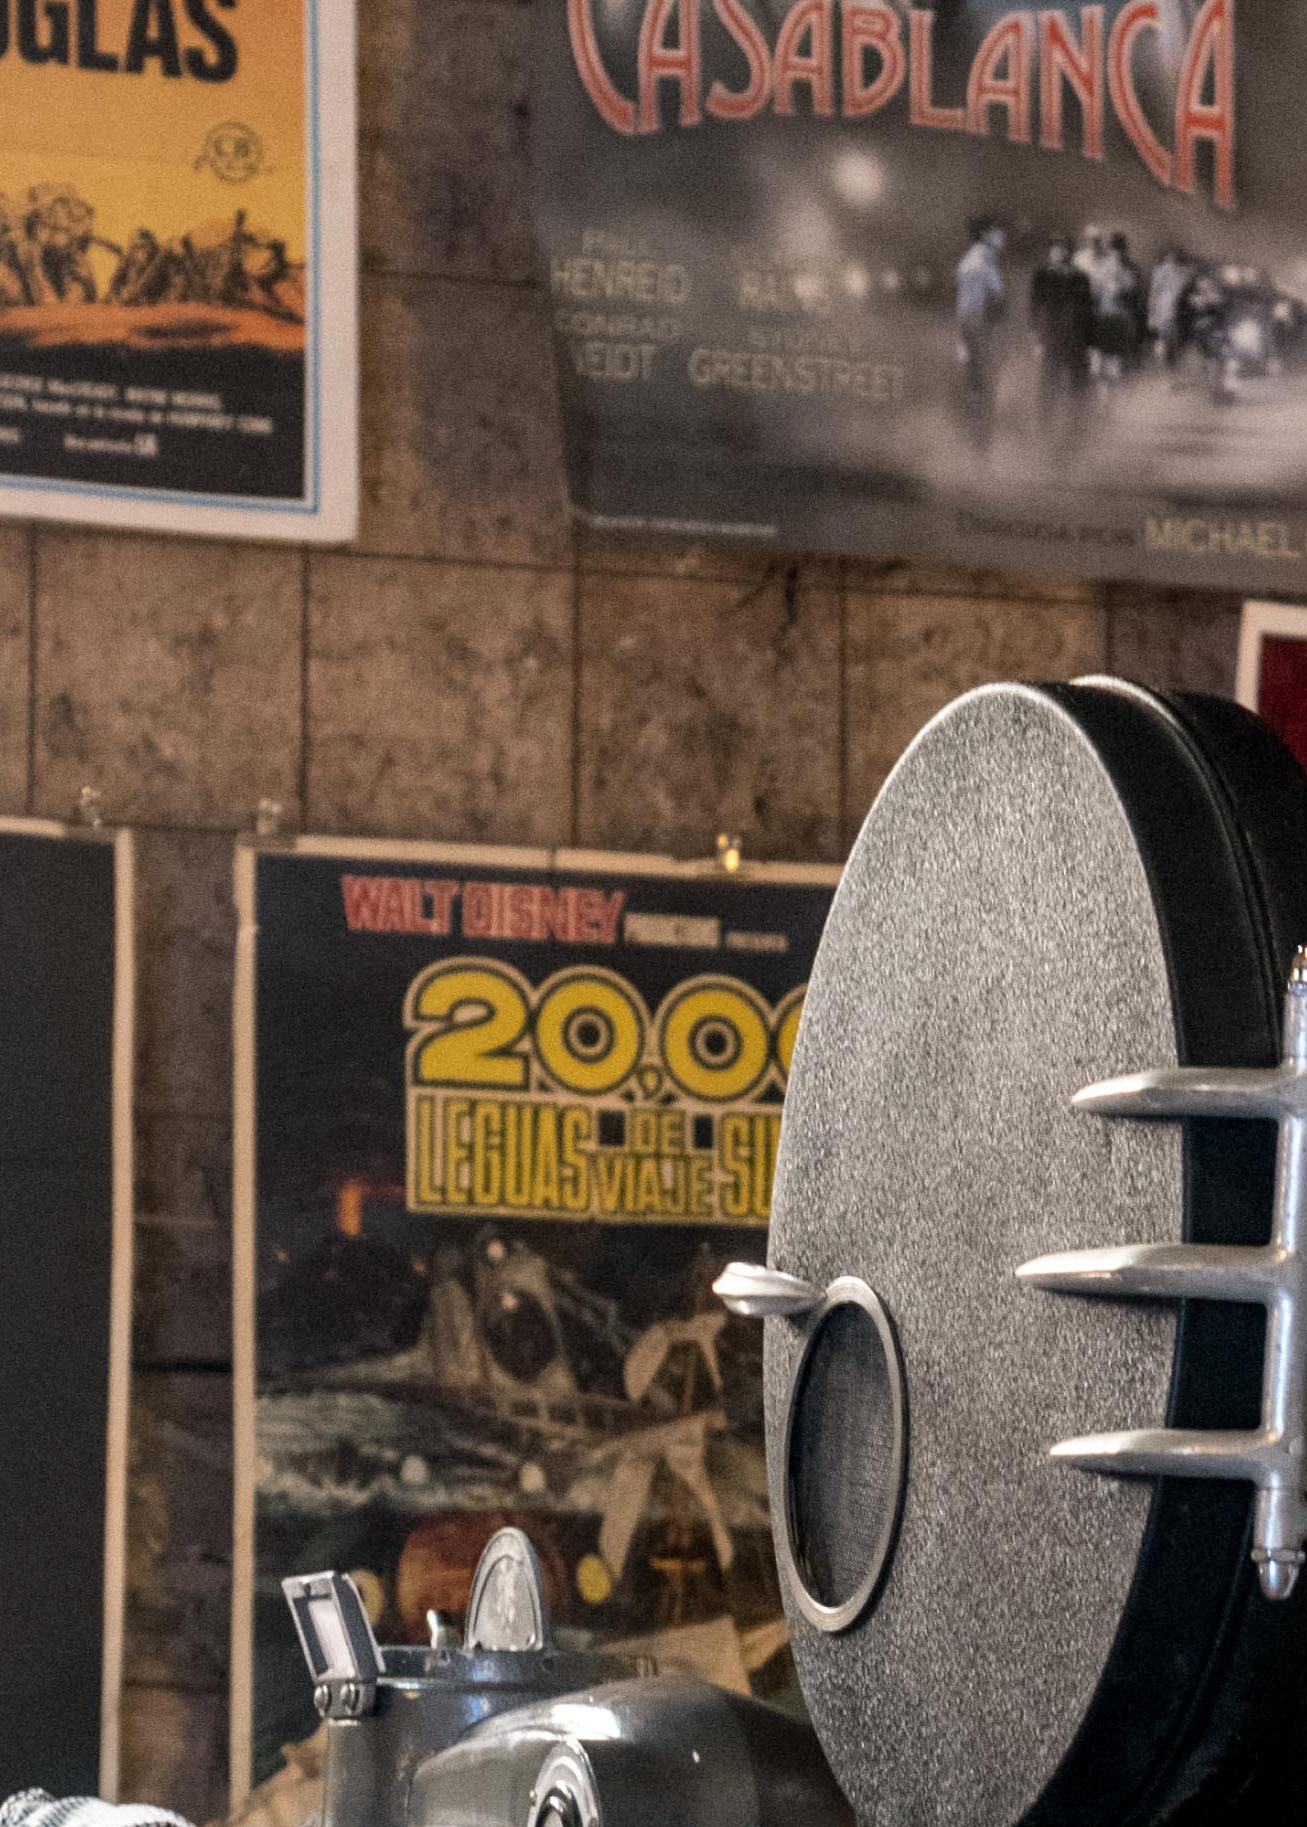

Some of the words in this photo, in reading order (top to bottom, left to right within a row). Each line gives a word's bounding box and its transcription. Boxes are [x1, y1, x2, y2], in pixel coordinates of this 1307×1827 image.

[567, 0, 1236, 210] CASABLANCA
[1146, 516, 1301, 559] MICHAEL
[341, 875, 459, 936] WALT
[461, 880, 625, 945] DISNEY
[414, 1098, 591, 1211] LEGUAS
[627, 1108, 686, 1151] DE
[596, 1154, 714, 1216] VIAJE
